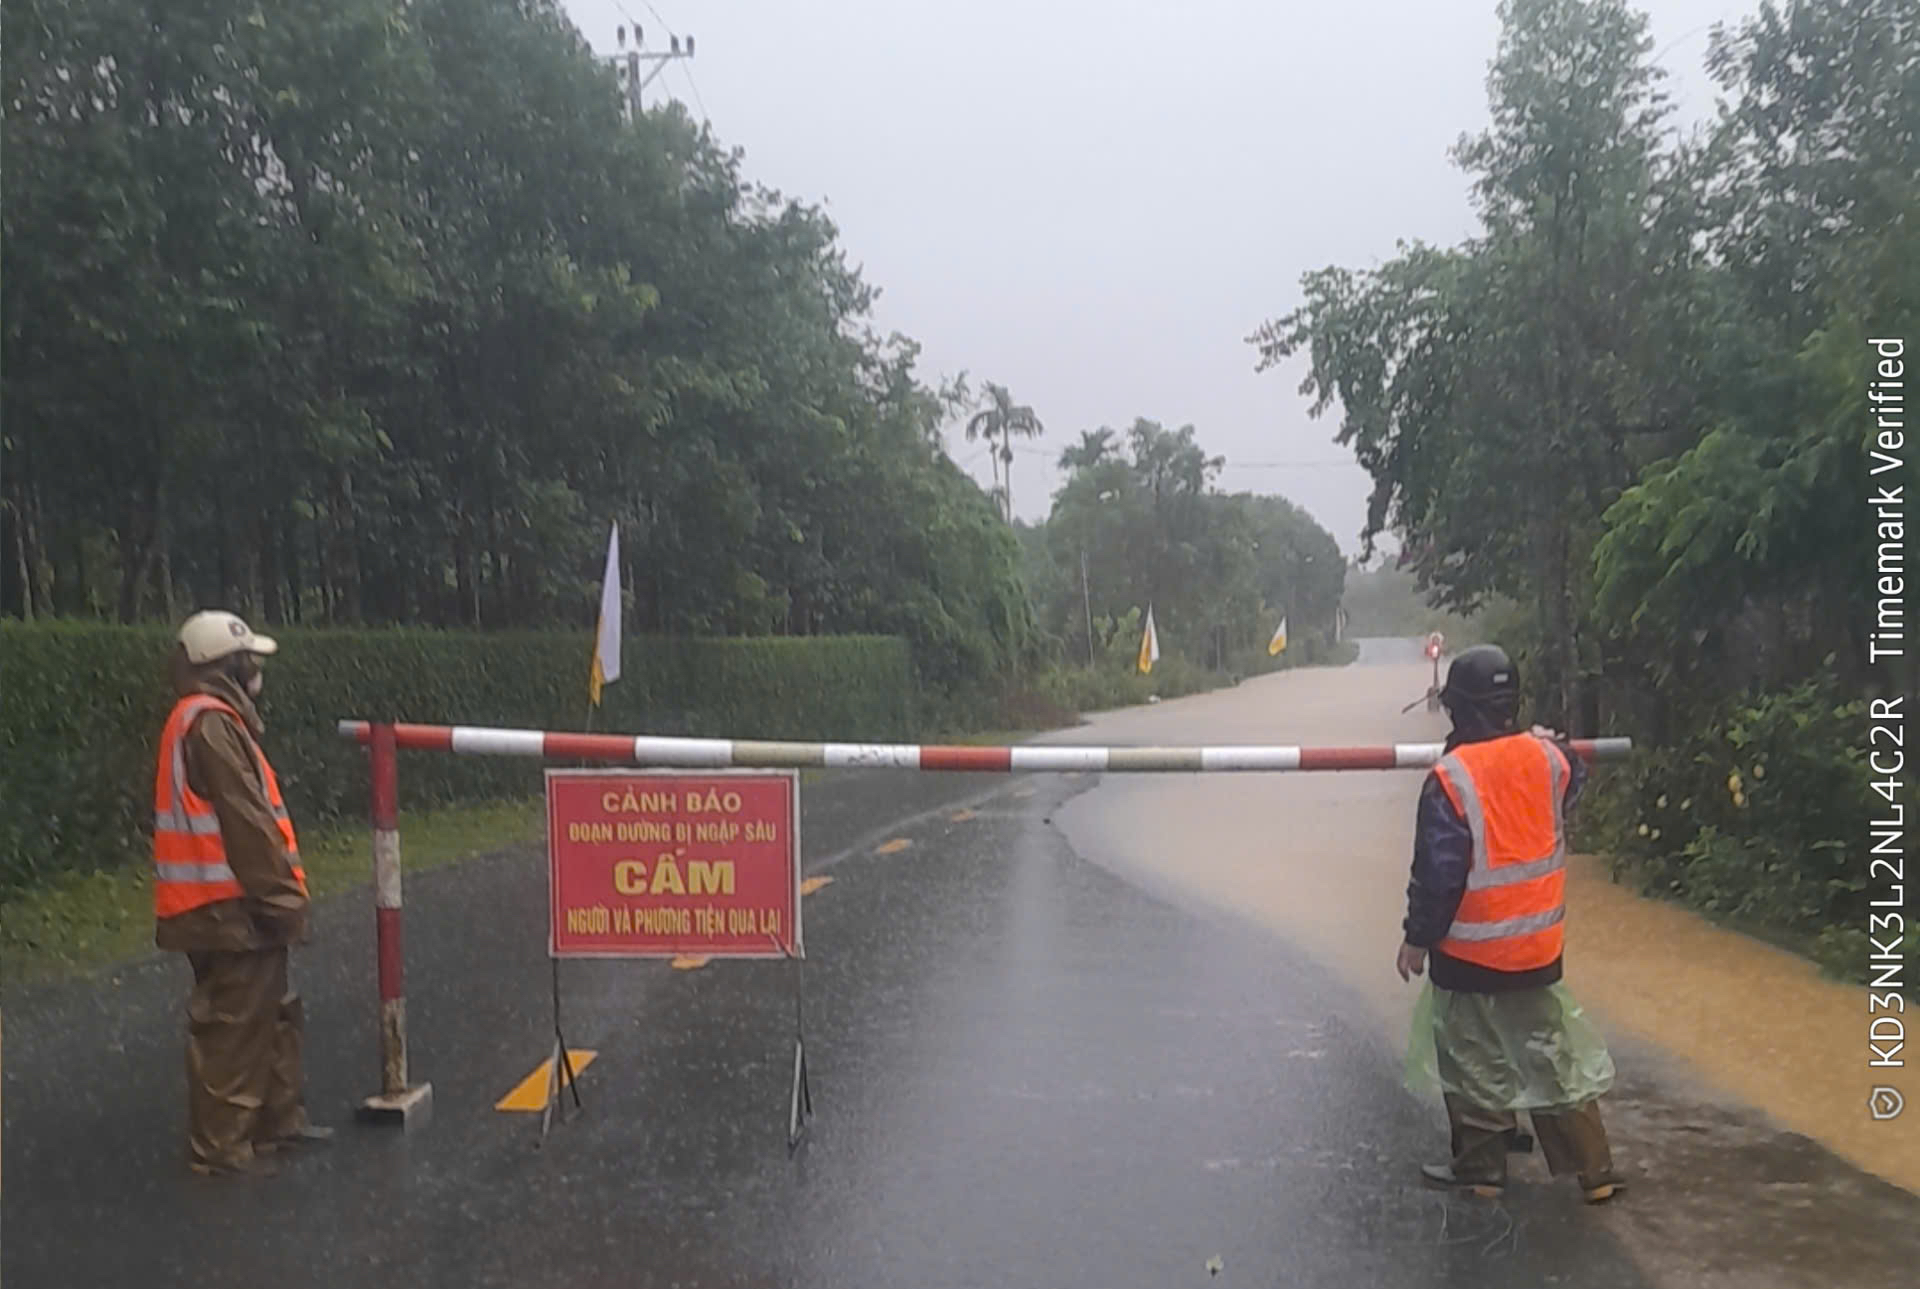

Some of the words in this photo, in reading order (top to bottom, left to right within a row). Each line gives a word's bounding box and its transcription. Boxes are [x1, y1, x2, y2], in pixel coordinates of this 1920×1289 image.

[603, 784, 677, 813] CẢNH
[687, 786, 742, 813] BÁO
[745, 819, 777, 841] SÂU
[613, 848, 736, 895] CẤM
[613, 903, 631, 934] VÀ
[729, 908, 756, 936] QUA
